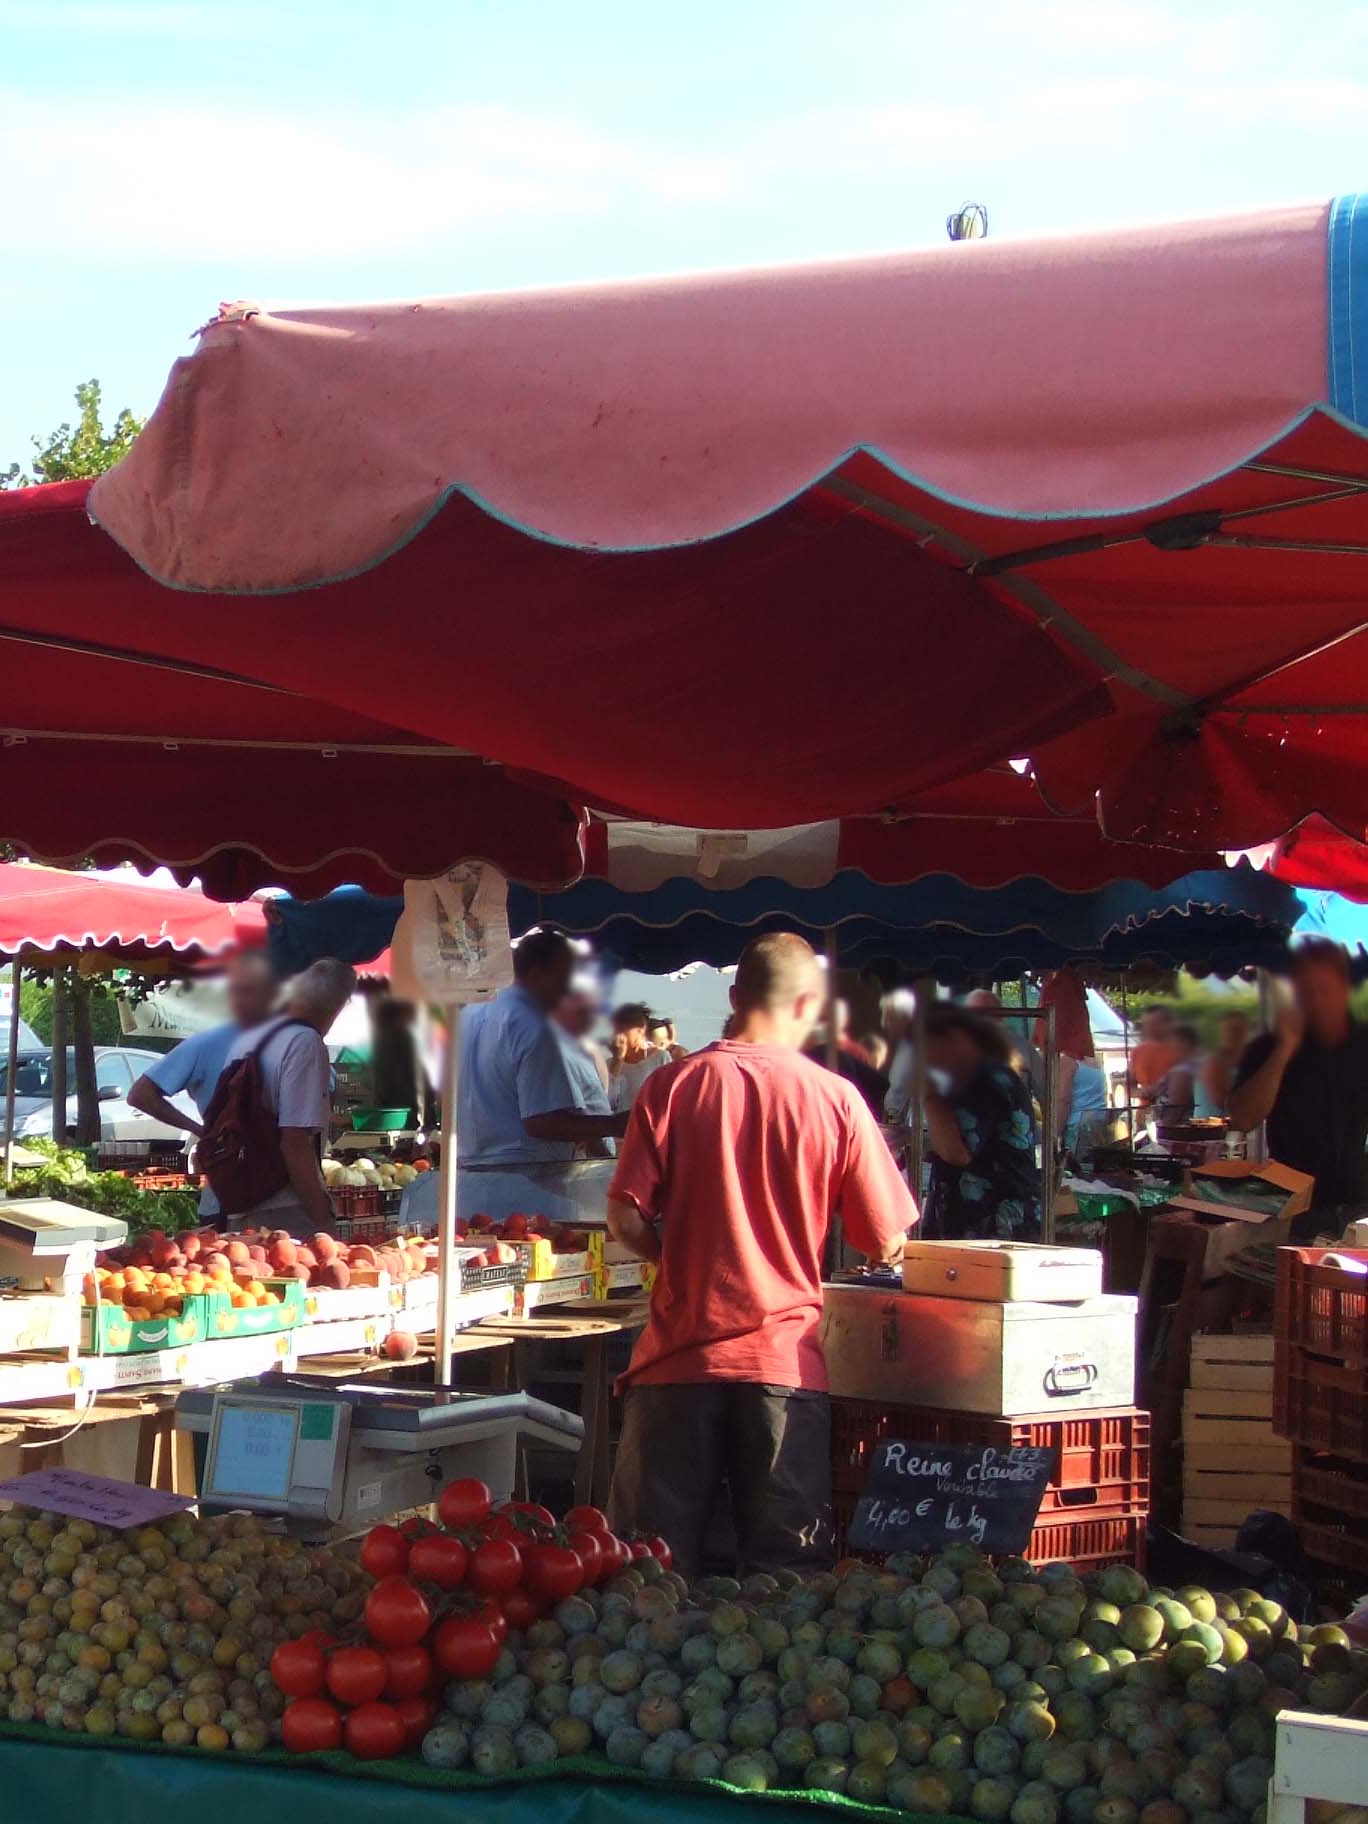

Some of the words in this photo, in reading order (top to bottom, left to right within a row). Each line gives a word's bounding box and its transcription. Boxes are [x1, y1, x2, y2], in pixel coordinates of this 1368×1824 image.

[884, 1443, 952, 1477] Reine
[945, 1502, 963, 1530] le
[967, 1504, 988, 1545] kg
